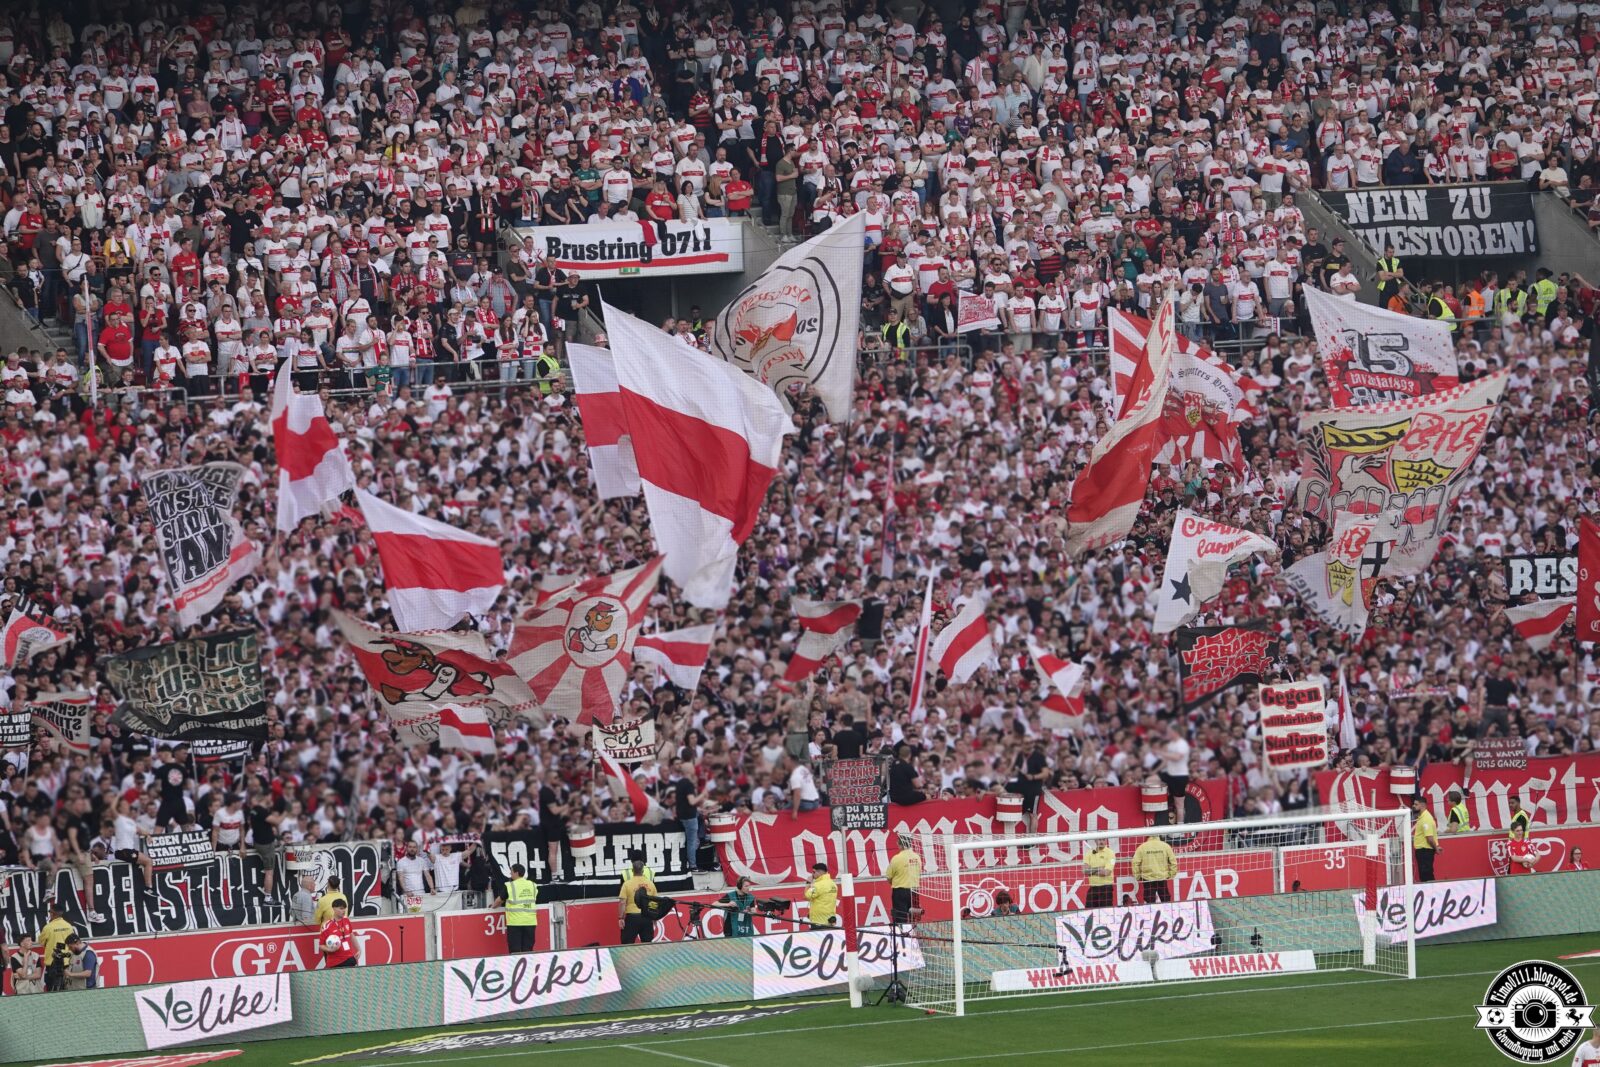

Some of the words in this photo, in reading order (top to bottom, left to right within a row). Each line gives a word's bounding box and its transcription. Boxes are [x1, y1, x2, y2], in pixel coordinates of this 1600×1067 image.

[1345, 190, 1429, 224] NEIN
[1449, 187, 1492, 220] ZU
[546, 231, 653, 263] Brustring
[1353, 219, 1536, 257] VESTOREN!
[1262, 687, 1322, 709] Gegen
[594, 745, 655, 759] SUTTGART
[1476, 760, 1496, 768] UMS
[1497, 759, 1527, 768] GANZE
[846, 805, 859, 813] DU
[846, 813, 885, 821] IMMER
[847, 820, 861, 828] BEI
[864, 820, 885, 828] UNS!
[182, 830, 210, 844] ALLE
[726, 788, 1120, 885] Commando
[148, 845, 187, 858] STADT-
[189, 841, 213, 854] UND
[1324, 850, 1346, 869] 35
[1018, 868, 1240, 913] JOKRTAR
[484, 914, 508, 937] 34
[1062, 901, 1201, 962] Velike!
[1027, 963, 1120, 988] WINAMAX
[1190, 953, 1284, 977] WINAMAX
[451, 949, 603, 1005] Velike!
[141, 973, 280, 1033] Velike!
